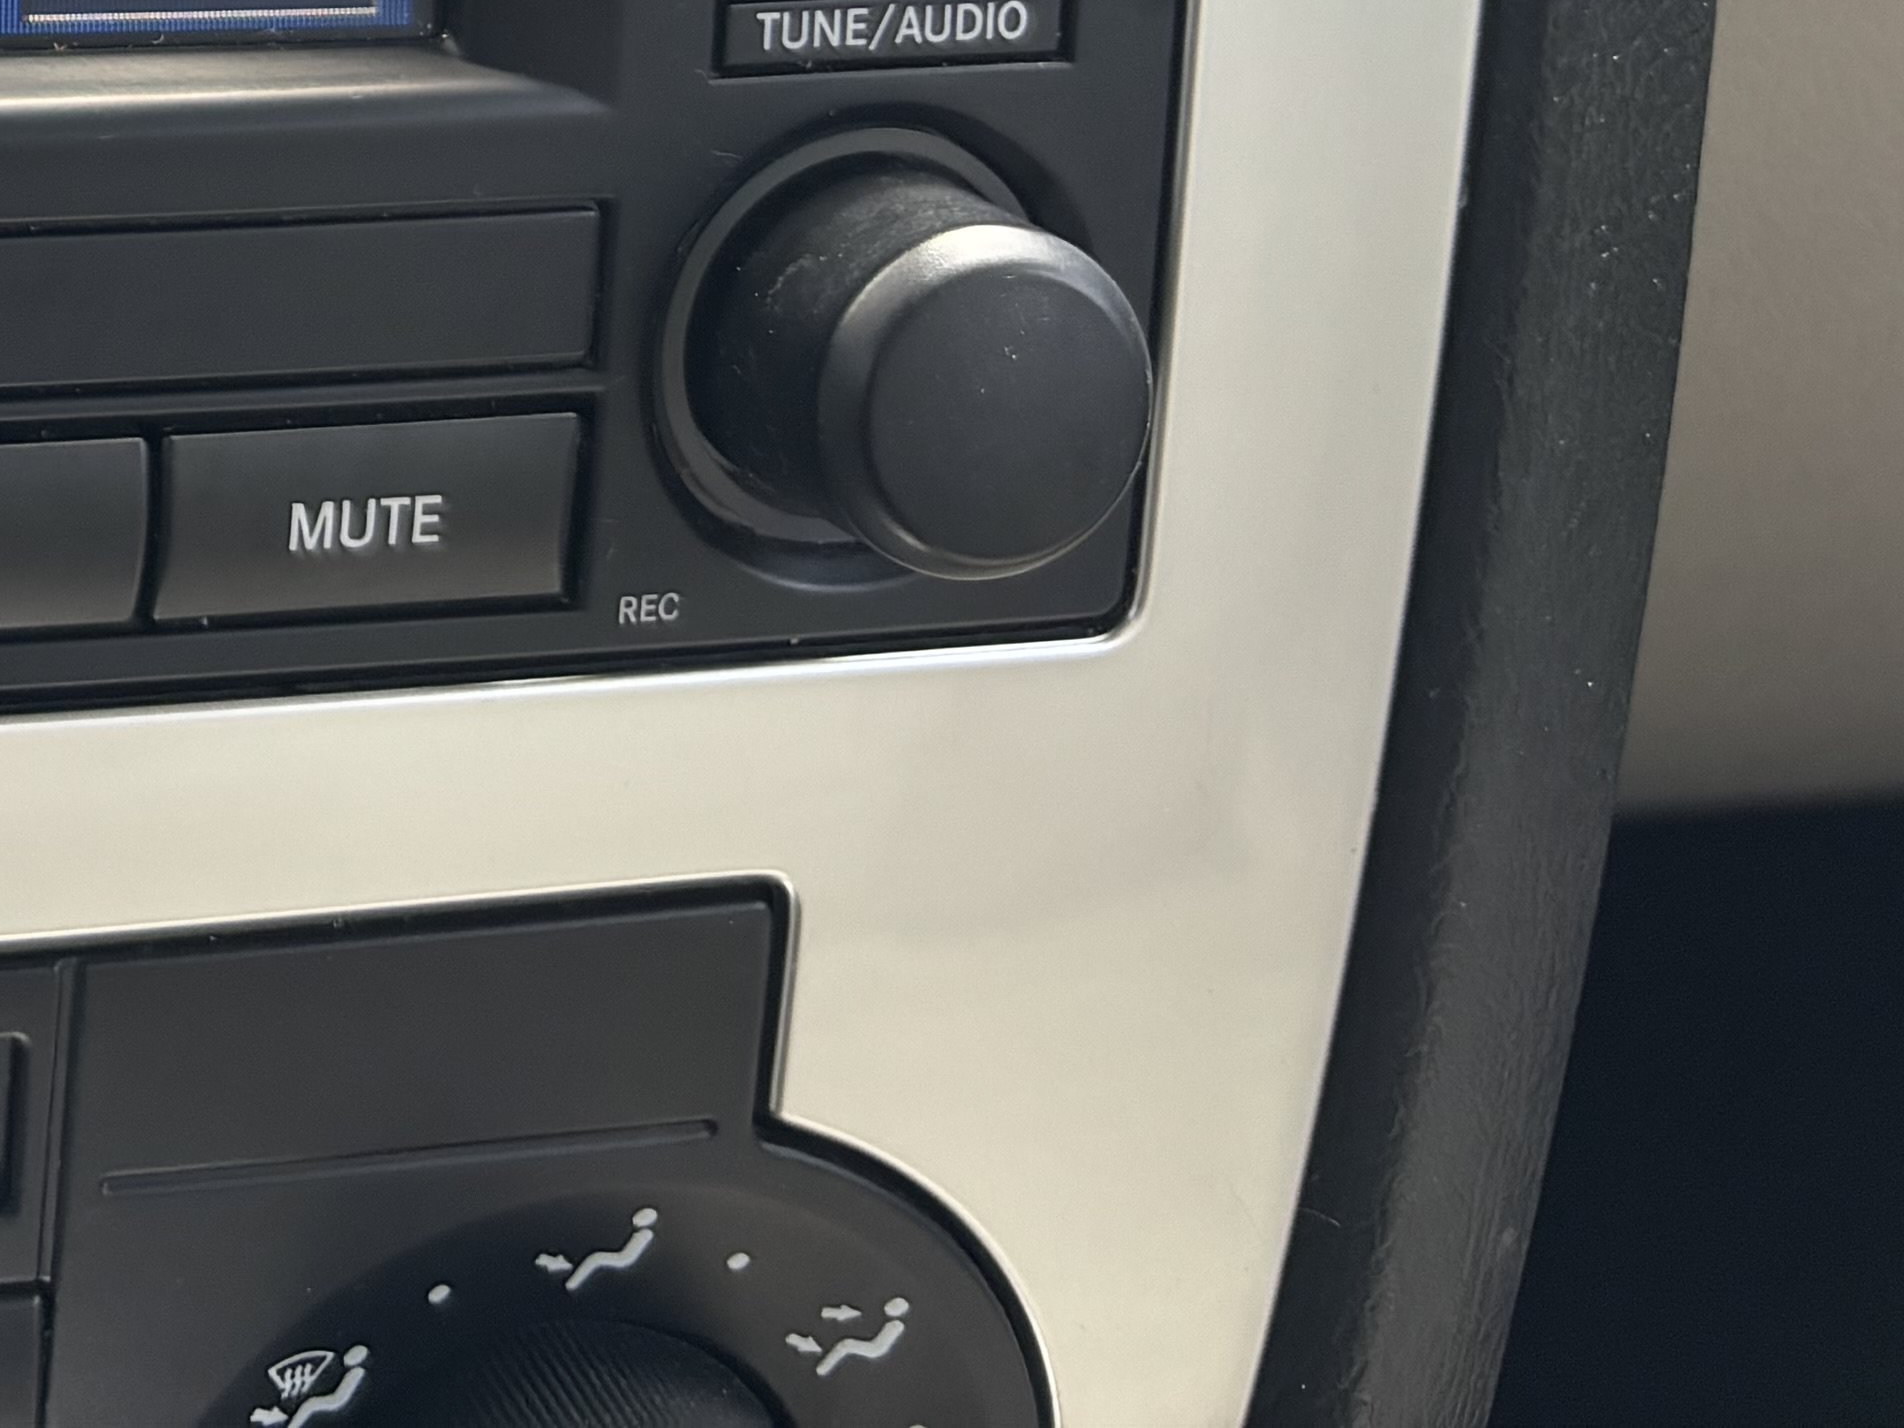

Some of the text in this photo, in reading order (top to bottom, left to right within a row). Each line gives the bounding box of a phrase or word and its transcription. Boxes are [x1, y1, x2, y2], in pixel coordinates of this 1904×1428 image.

[756, 0, 1029, 51] TUNE/AUDIO
[288, 494, 444, 553] MUTE
[618, 592, 682, 625] REC
